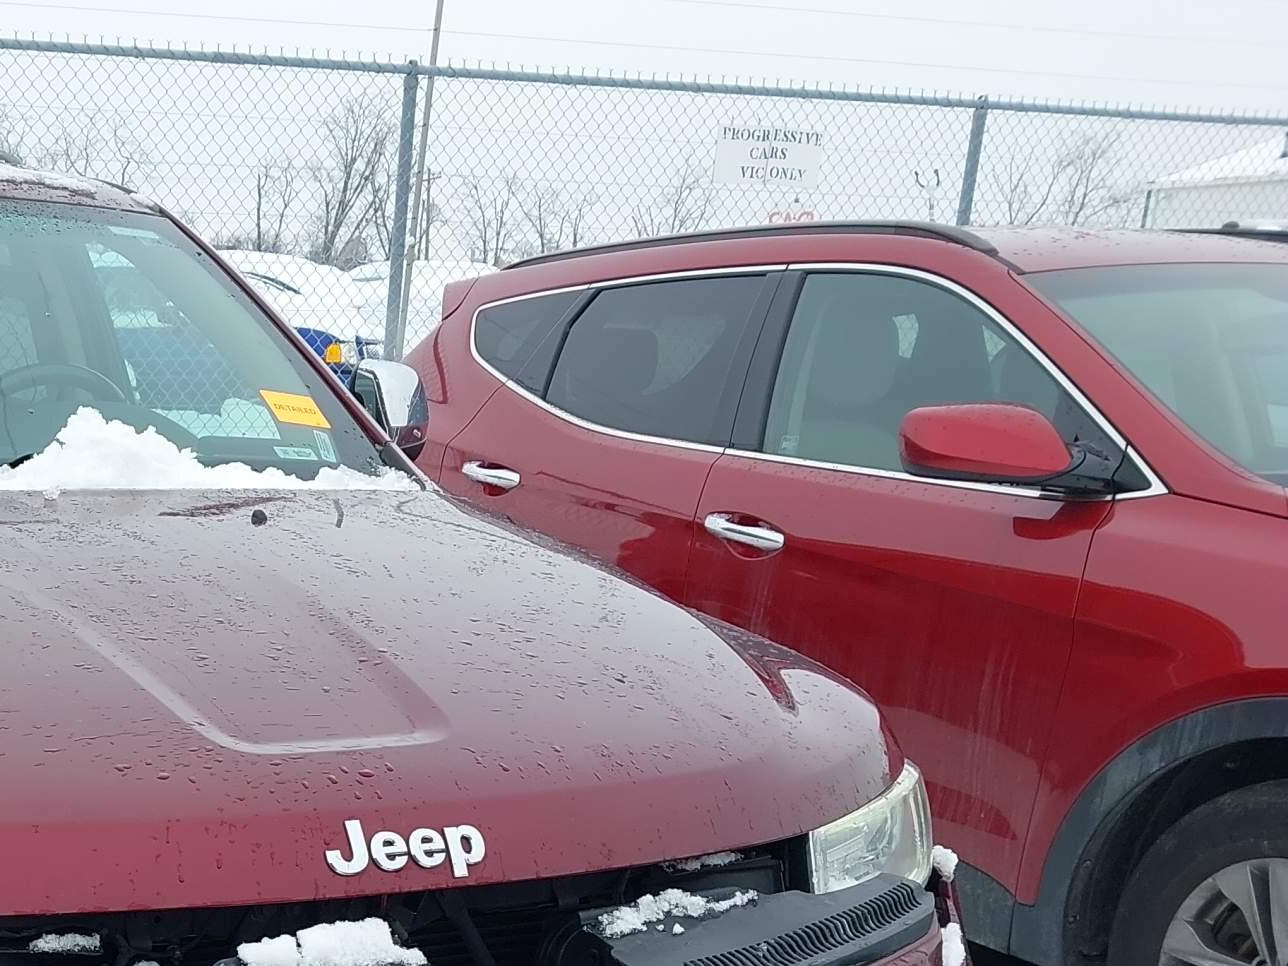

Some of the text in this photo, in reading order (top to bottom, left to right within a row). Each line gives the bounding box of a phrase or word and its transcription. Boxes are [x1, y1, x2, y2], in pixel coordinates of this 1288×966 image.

[722, 126, 823, 146] PROGRESSIVE
[750, 146, 788, 160] CARS
[769, 166, 807, 181] ONLY
[325, 819, 486, 878] Jeep
